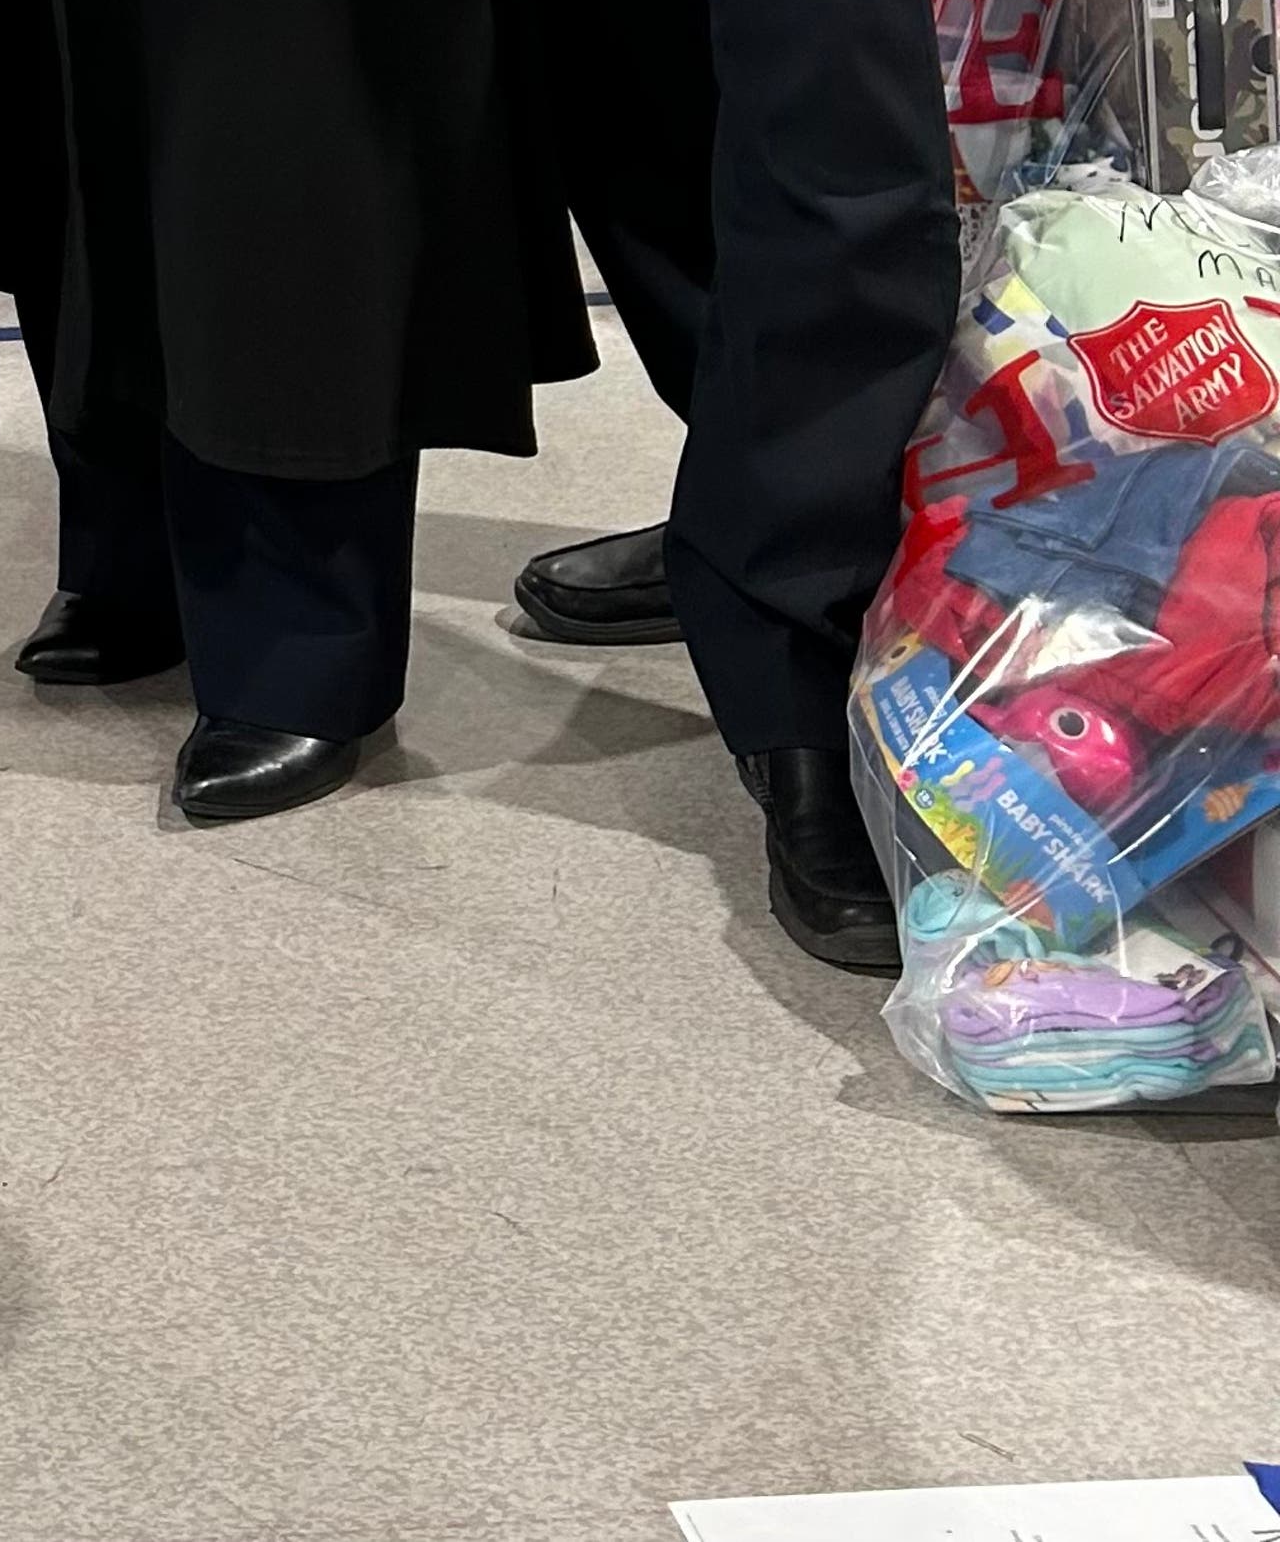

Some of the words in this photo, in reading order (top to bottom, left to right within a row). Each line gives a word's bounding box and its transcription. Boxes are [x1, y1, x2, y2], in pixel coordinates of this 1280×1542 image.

[1108, 316, 1169, 376] THE
[1109, 315, 1236, 420] SALVATION
[1170, 351, 1247, 433] ARMY
[995, 788, 1053, 842] BABY
[1042, 837, 1114, 904] SHARK
